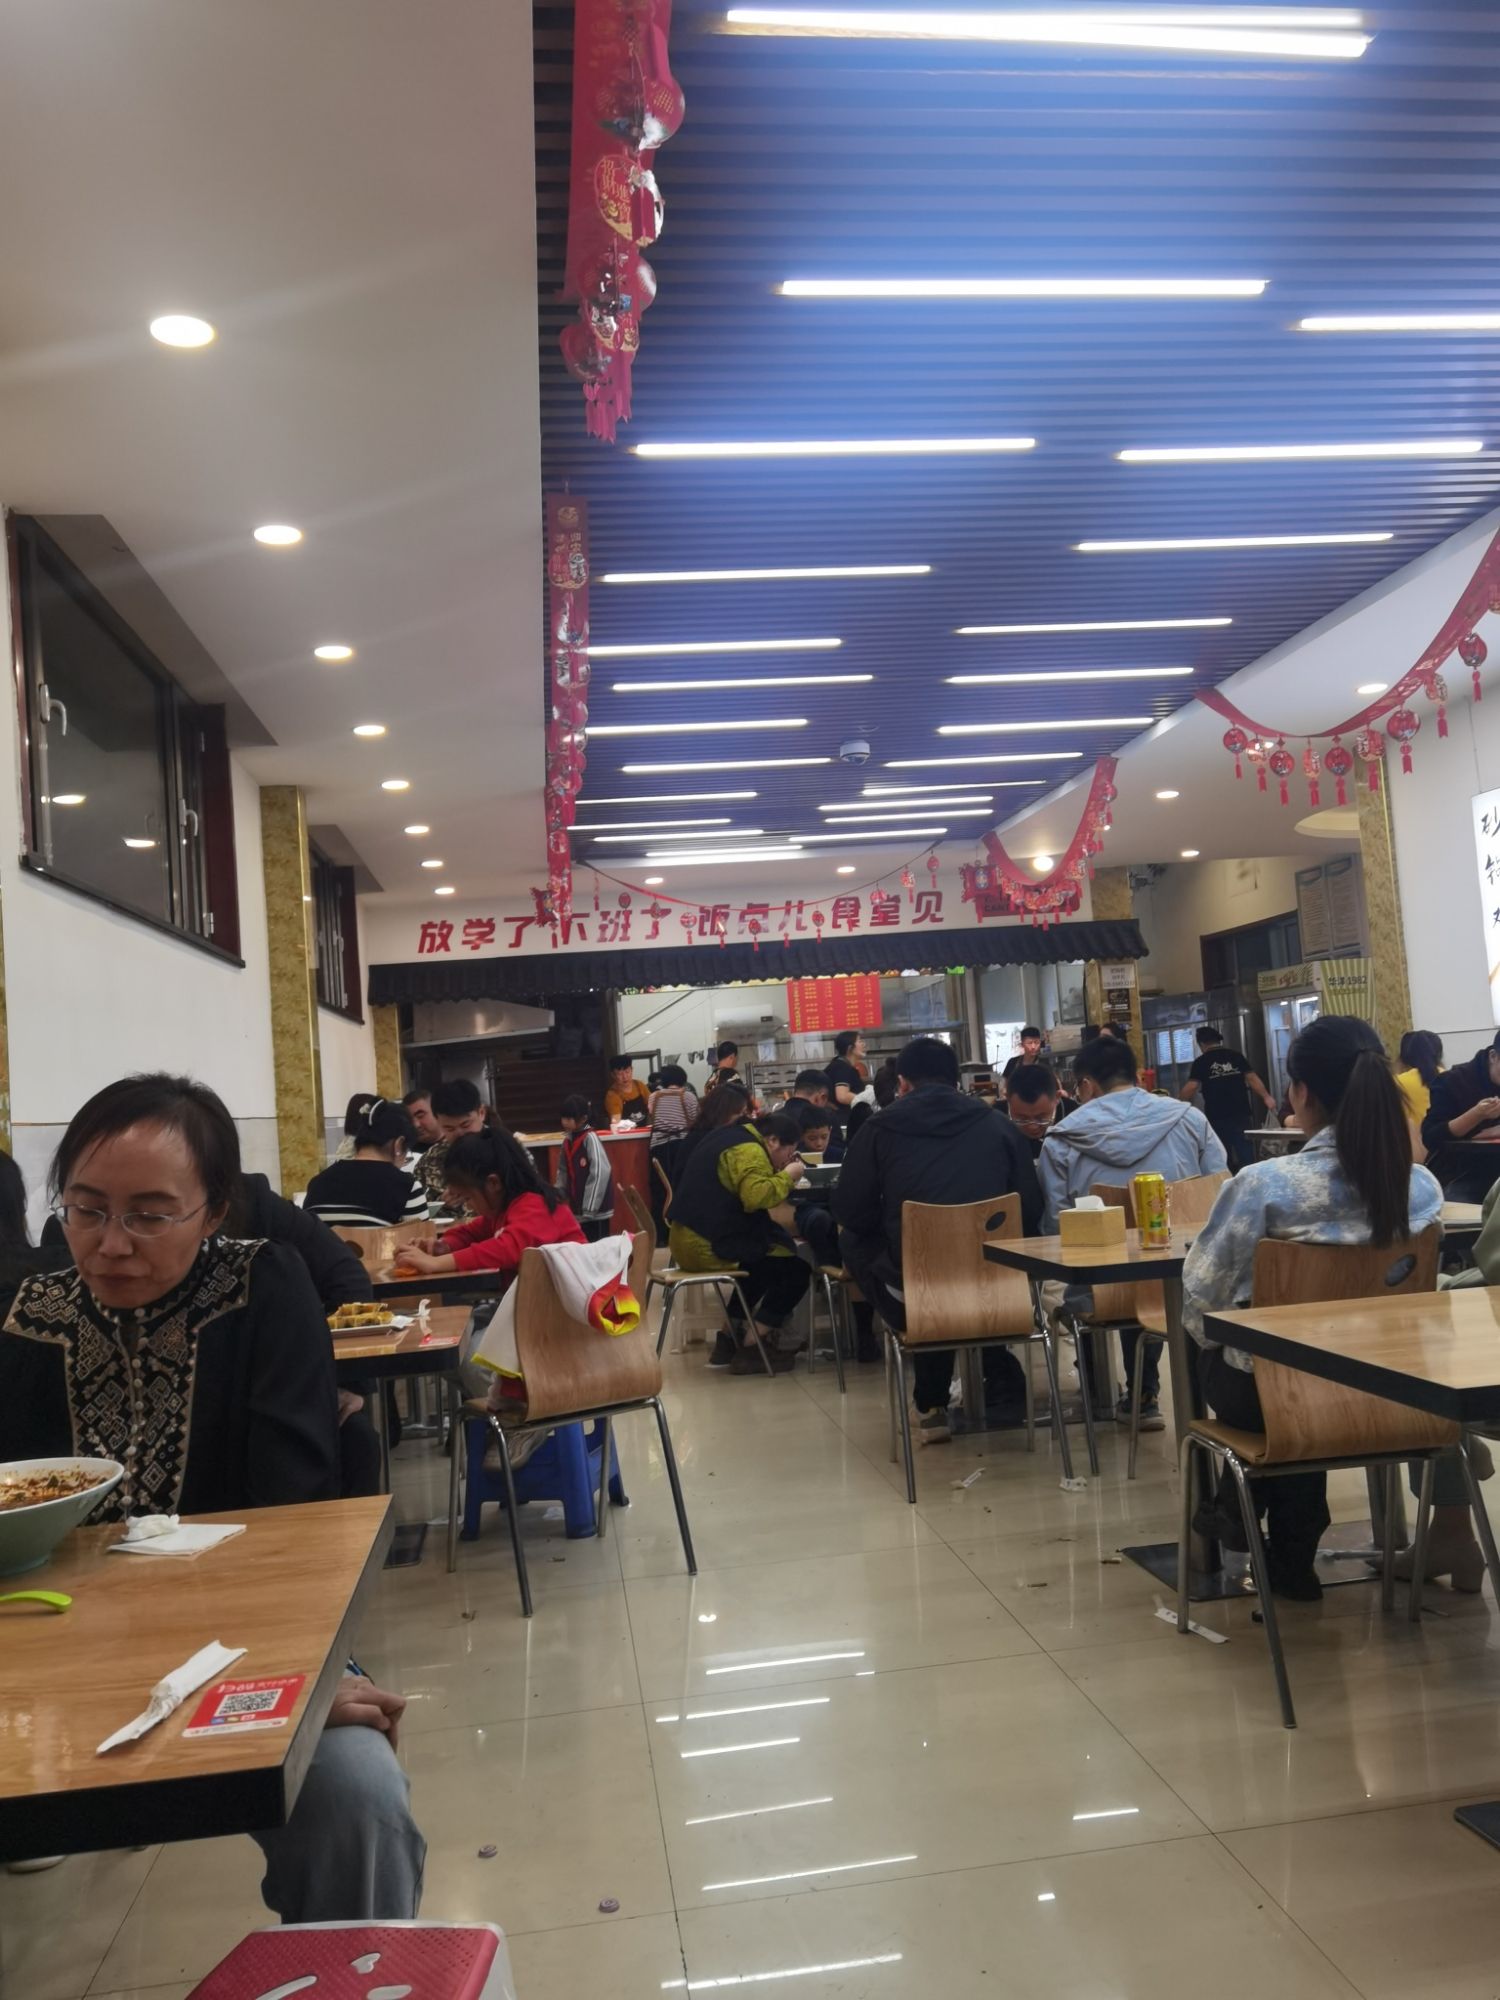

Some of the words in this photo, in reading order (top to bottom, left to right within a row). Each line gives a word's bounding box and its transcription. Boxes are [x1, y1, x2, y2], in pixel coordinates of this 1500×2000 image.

[417, 916, 537, 953] 放学了
[698, 900, 808, 936] 饭点儿
[832, 891, 944, 929] 食堂见
